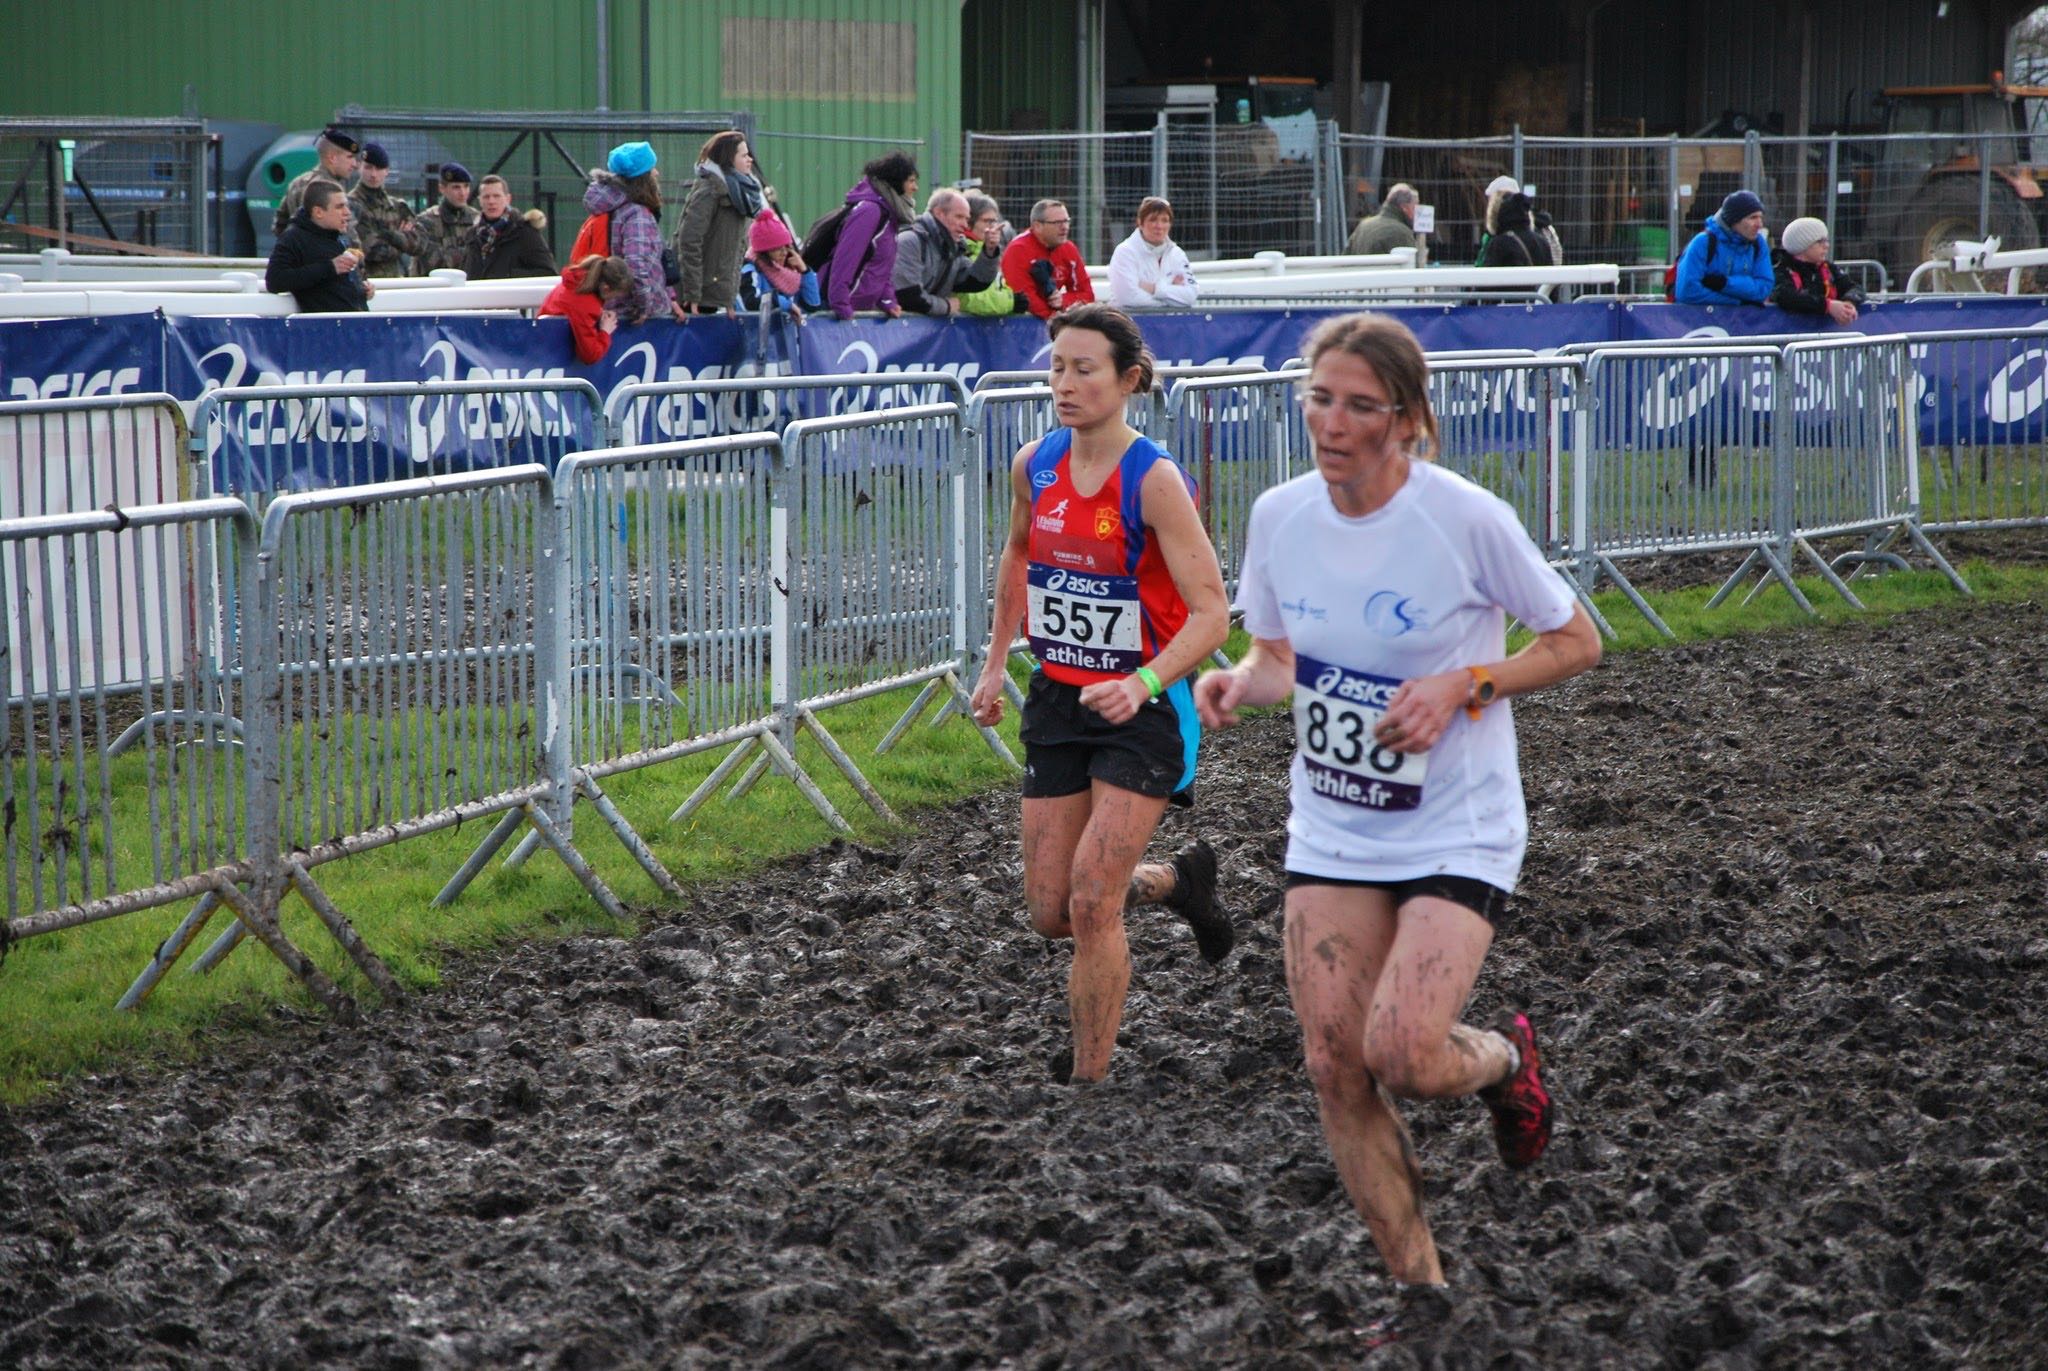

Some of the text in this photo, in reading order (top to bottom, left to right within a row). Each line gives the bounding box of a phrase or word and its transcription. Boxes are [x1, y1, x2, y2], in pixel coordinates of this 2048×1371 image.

[1066, 575, 1110, 597] asics
[1042, 595, 1123, 646] 557
[1046, 646, 1120, 670] athle.fr
[1307, 768, 1393, 807] athle.fr
